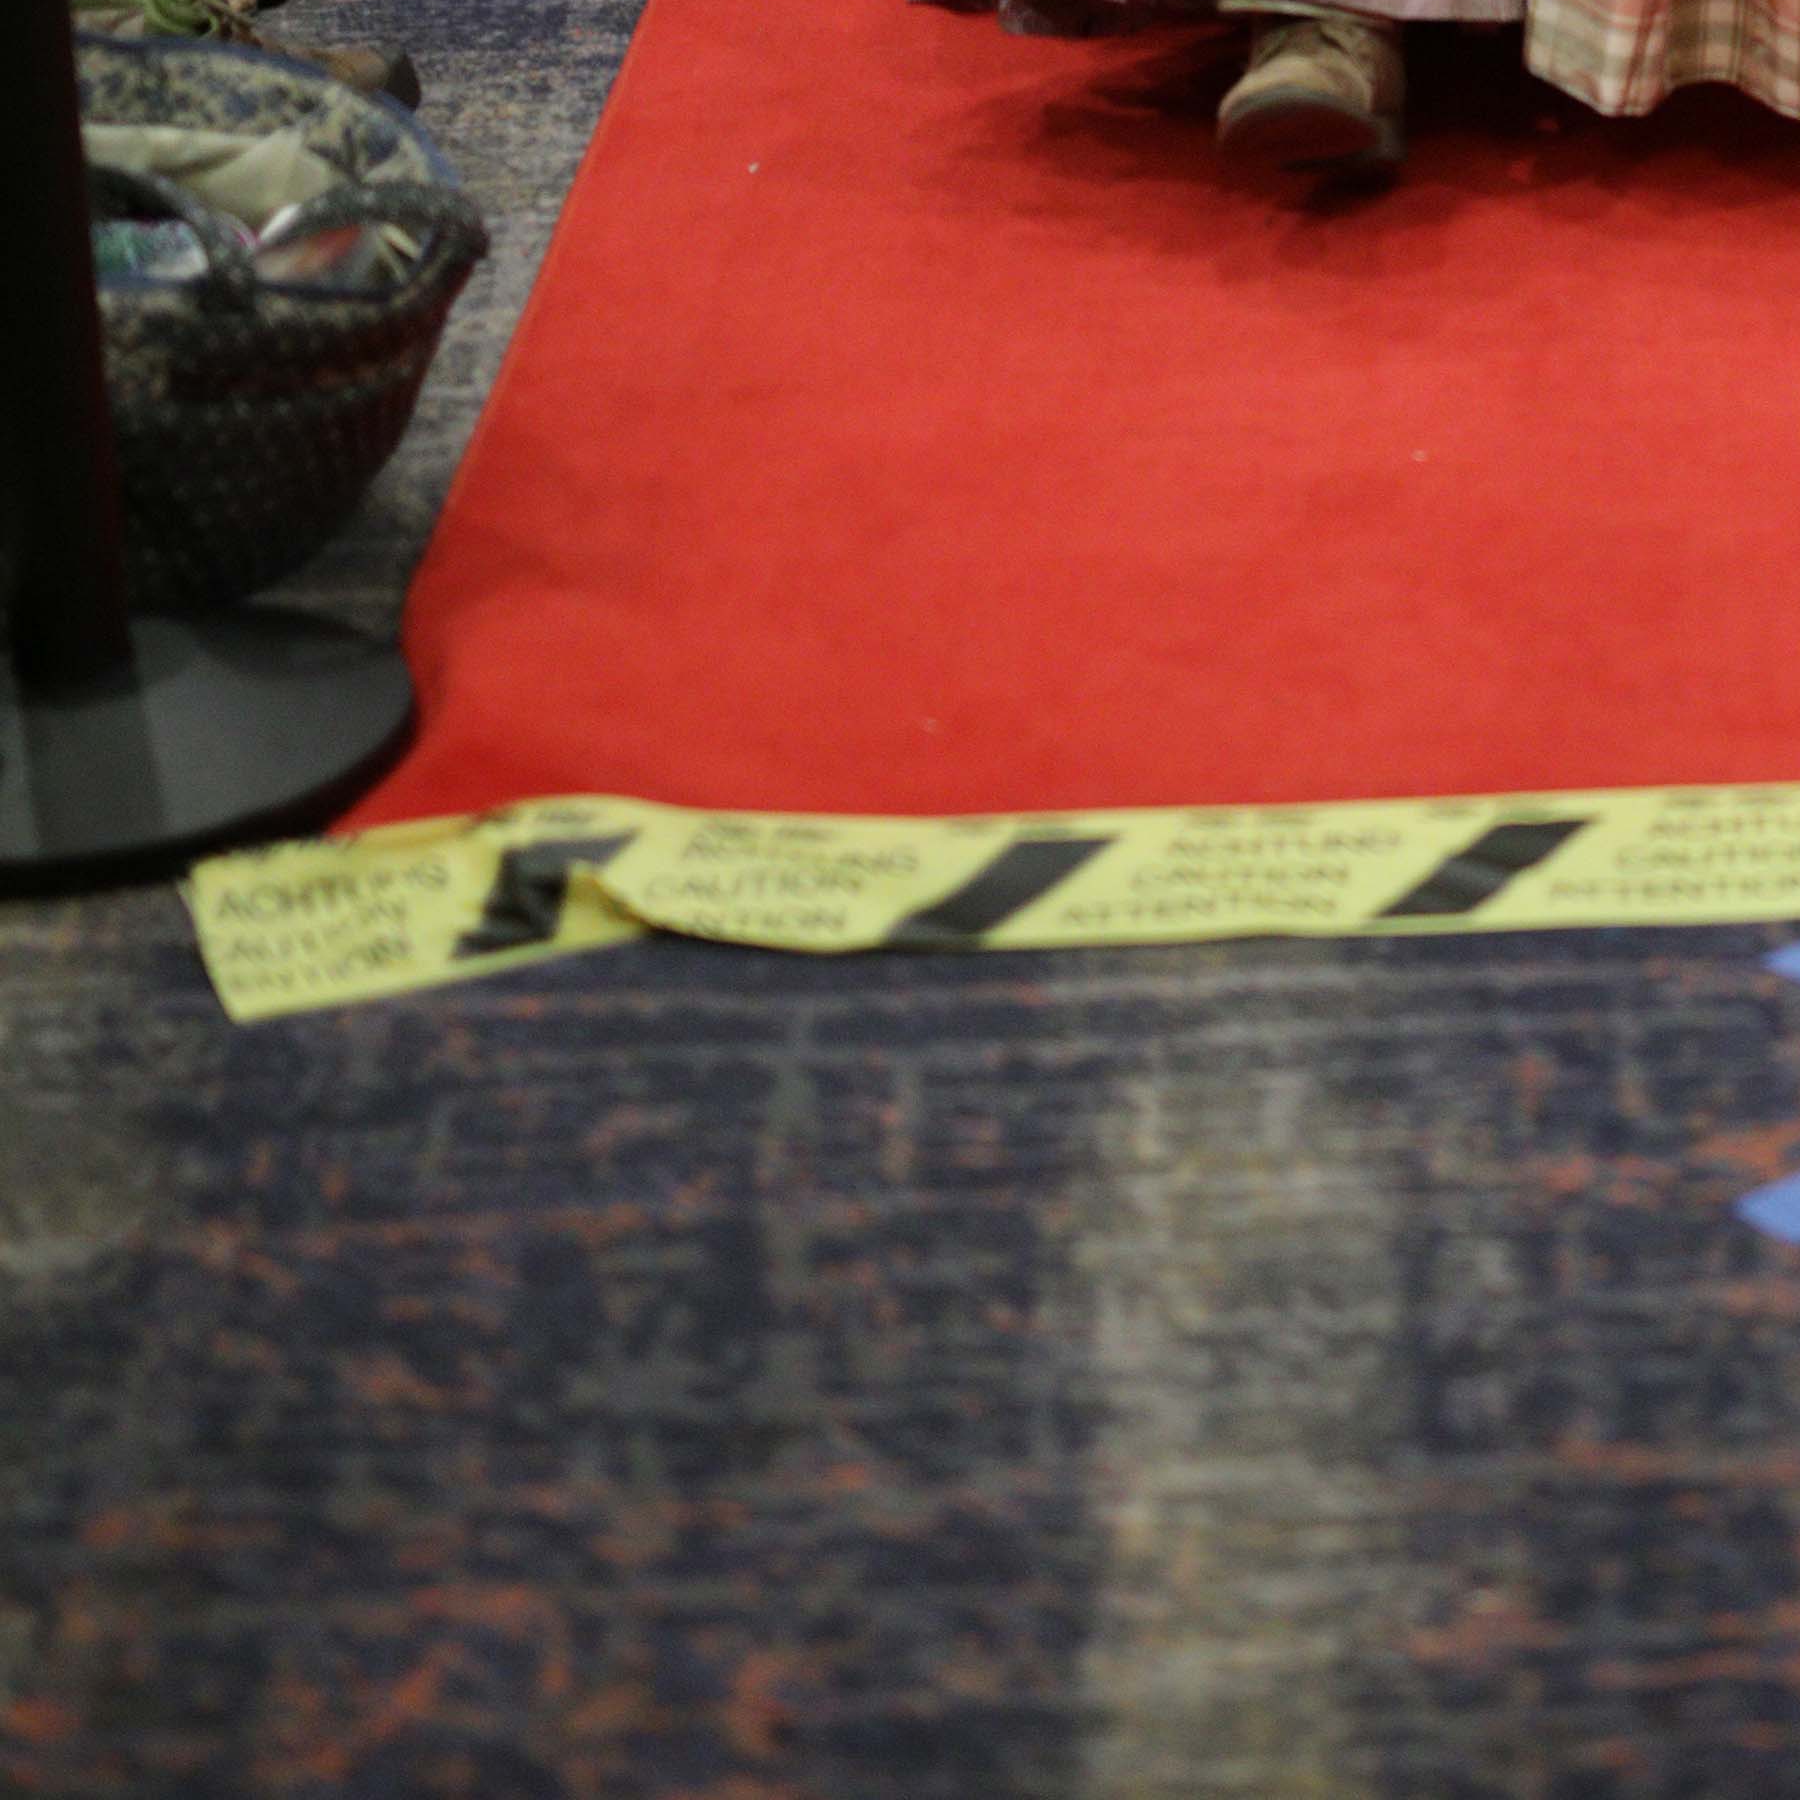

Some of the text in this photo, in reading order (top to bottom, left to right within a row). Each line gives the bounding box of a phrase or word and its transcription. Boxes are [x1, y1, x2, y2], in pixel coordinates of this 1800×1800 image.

[1163, 828, 1405, 858] ACHTUNG
[645, 863, 864, 904] CAUTION
[1126, 861, 1350, 891] CAUTION
[1059, 891, 1338, 926] ATTENTION
[222, 900, 412, 964] AUTION
